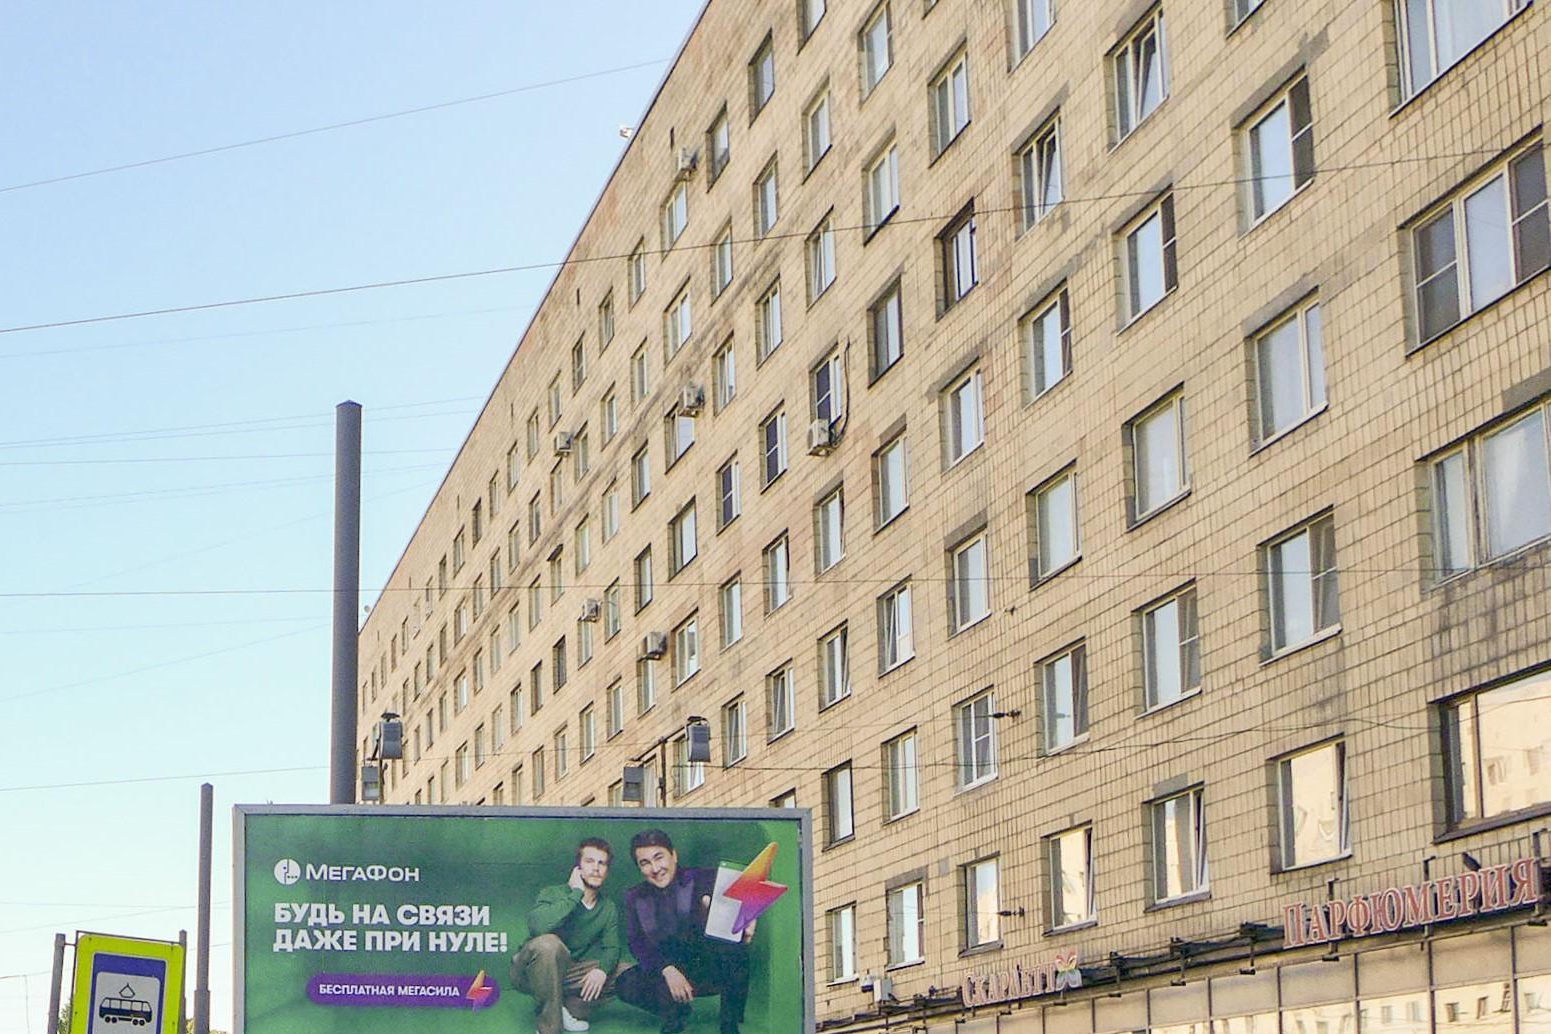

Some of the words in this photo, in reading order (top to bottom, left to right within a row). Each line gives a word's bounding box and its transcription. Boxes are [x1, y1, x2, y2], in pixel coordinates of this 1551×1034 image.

[274, 903, 345, 927] БУДЬ
[352, 904, 390, 924] НА
[396, 905, 490, 926] СВЯЗИ
[1282, 858, 1538, 949] ПАРФЮМЕРИЯ
[273, 929, 357, 952] ДАЖЕ
[365, 931, 420, 951] ПРИ
[428, 932, 508, 952] НУЛЕ!
[319, 984, 395, 995] БЕСПЛАТНАЯ
[398, 985, 460, 997] МЕГАСИЛА
[961, 963, 1056, 1008] СКАРЛЕТТ
